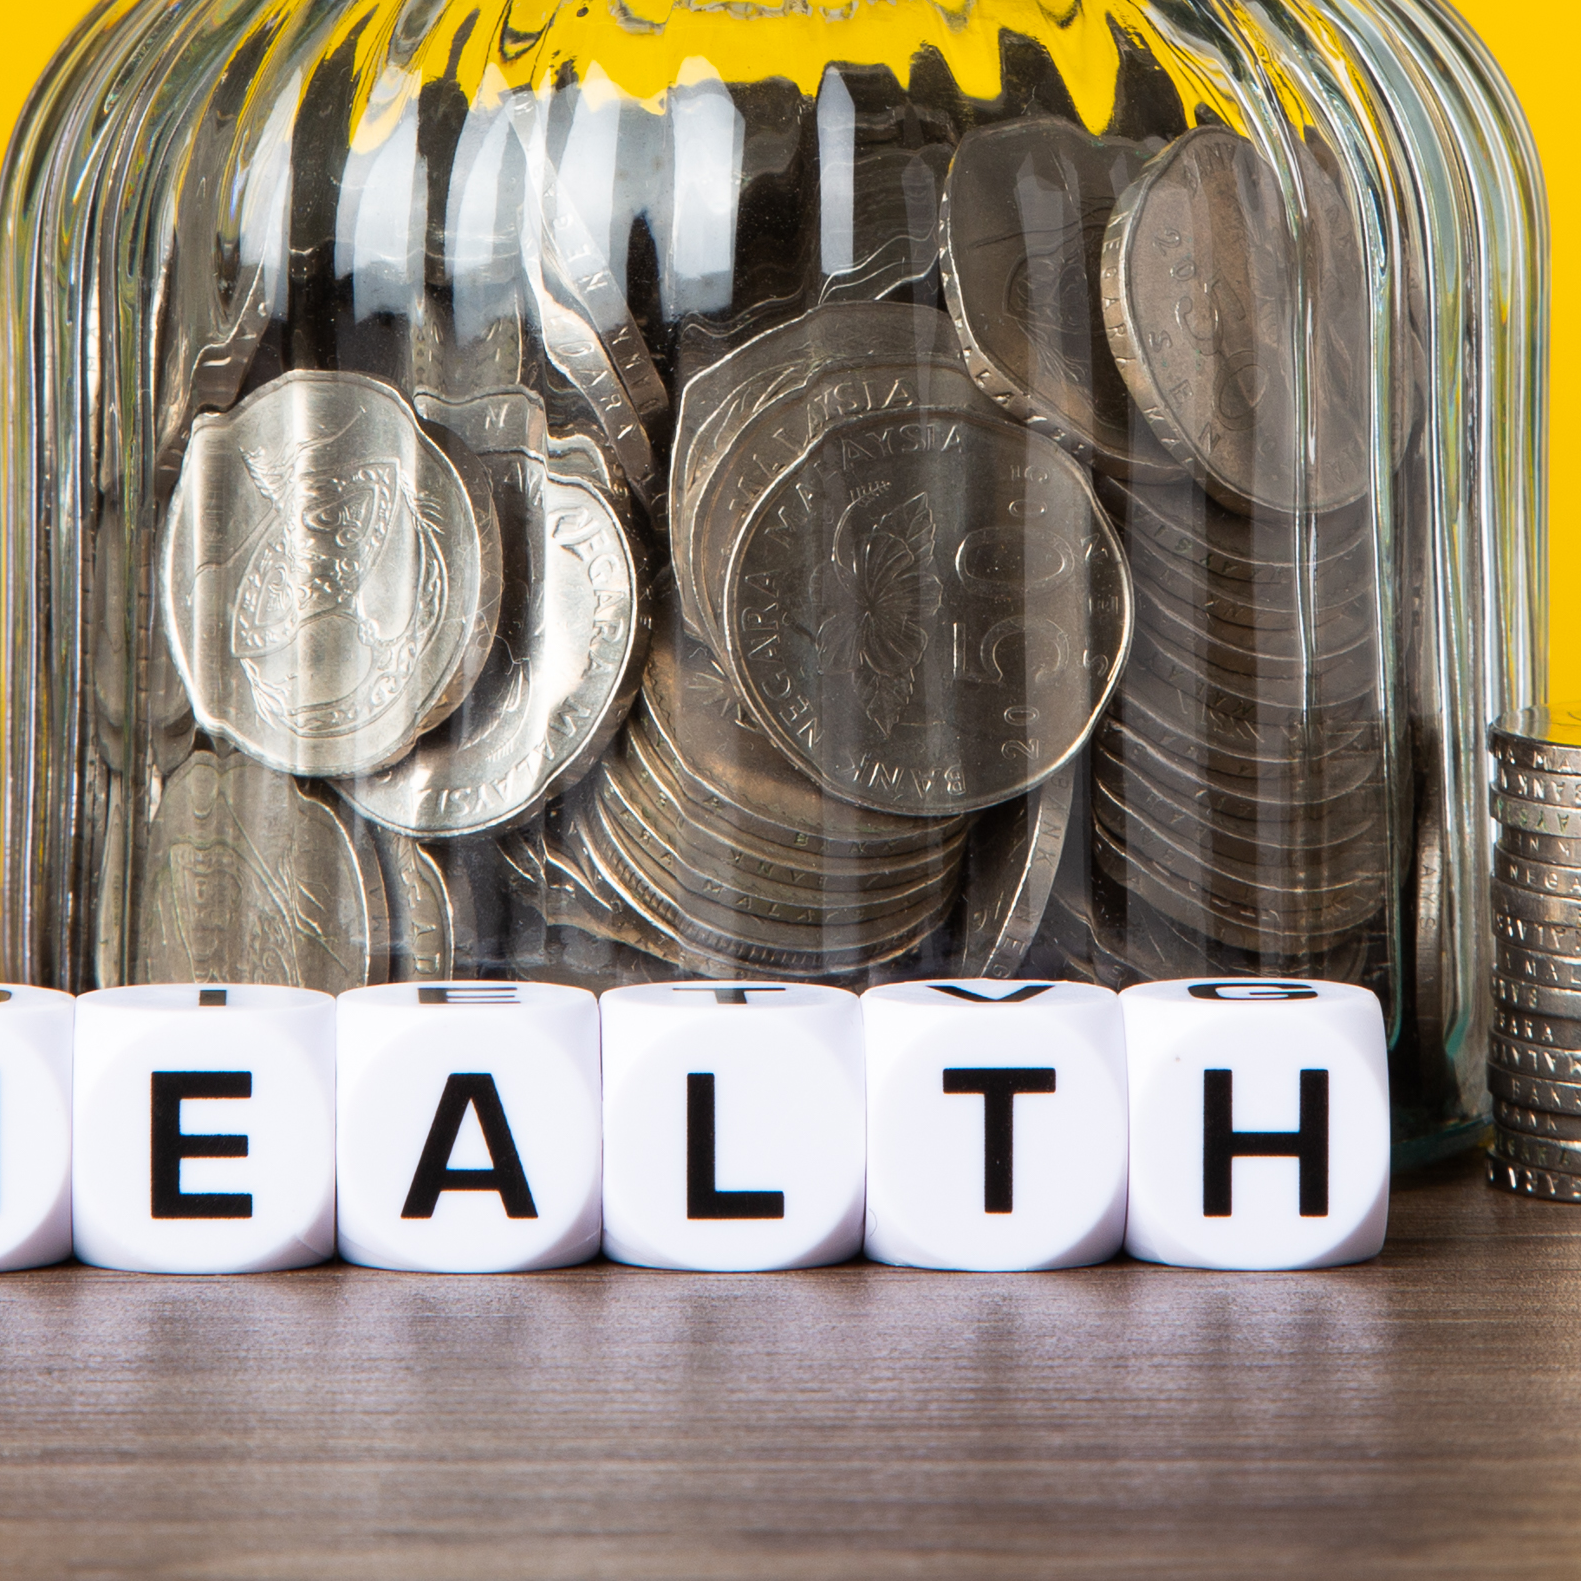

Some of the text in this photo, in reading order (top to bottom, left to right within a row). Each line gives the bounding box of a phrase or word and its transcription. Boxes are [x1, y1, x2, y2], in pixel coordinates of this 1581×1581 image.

[1148, 329, 1221, 455] SEN
[420, 506, 625, 817] NEGARA MALAYSIA
[739, 421, 968, 798] BANK NEGARA MALAYSIA
[954, 524, 1076, 686] 50
[418, 987, 521, 1004] E
[672, 987, 786, 1004] T
[926, 985, 1055, 1003] V
[1187, 983, 1319, 1001] G
